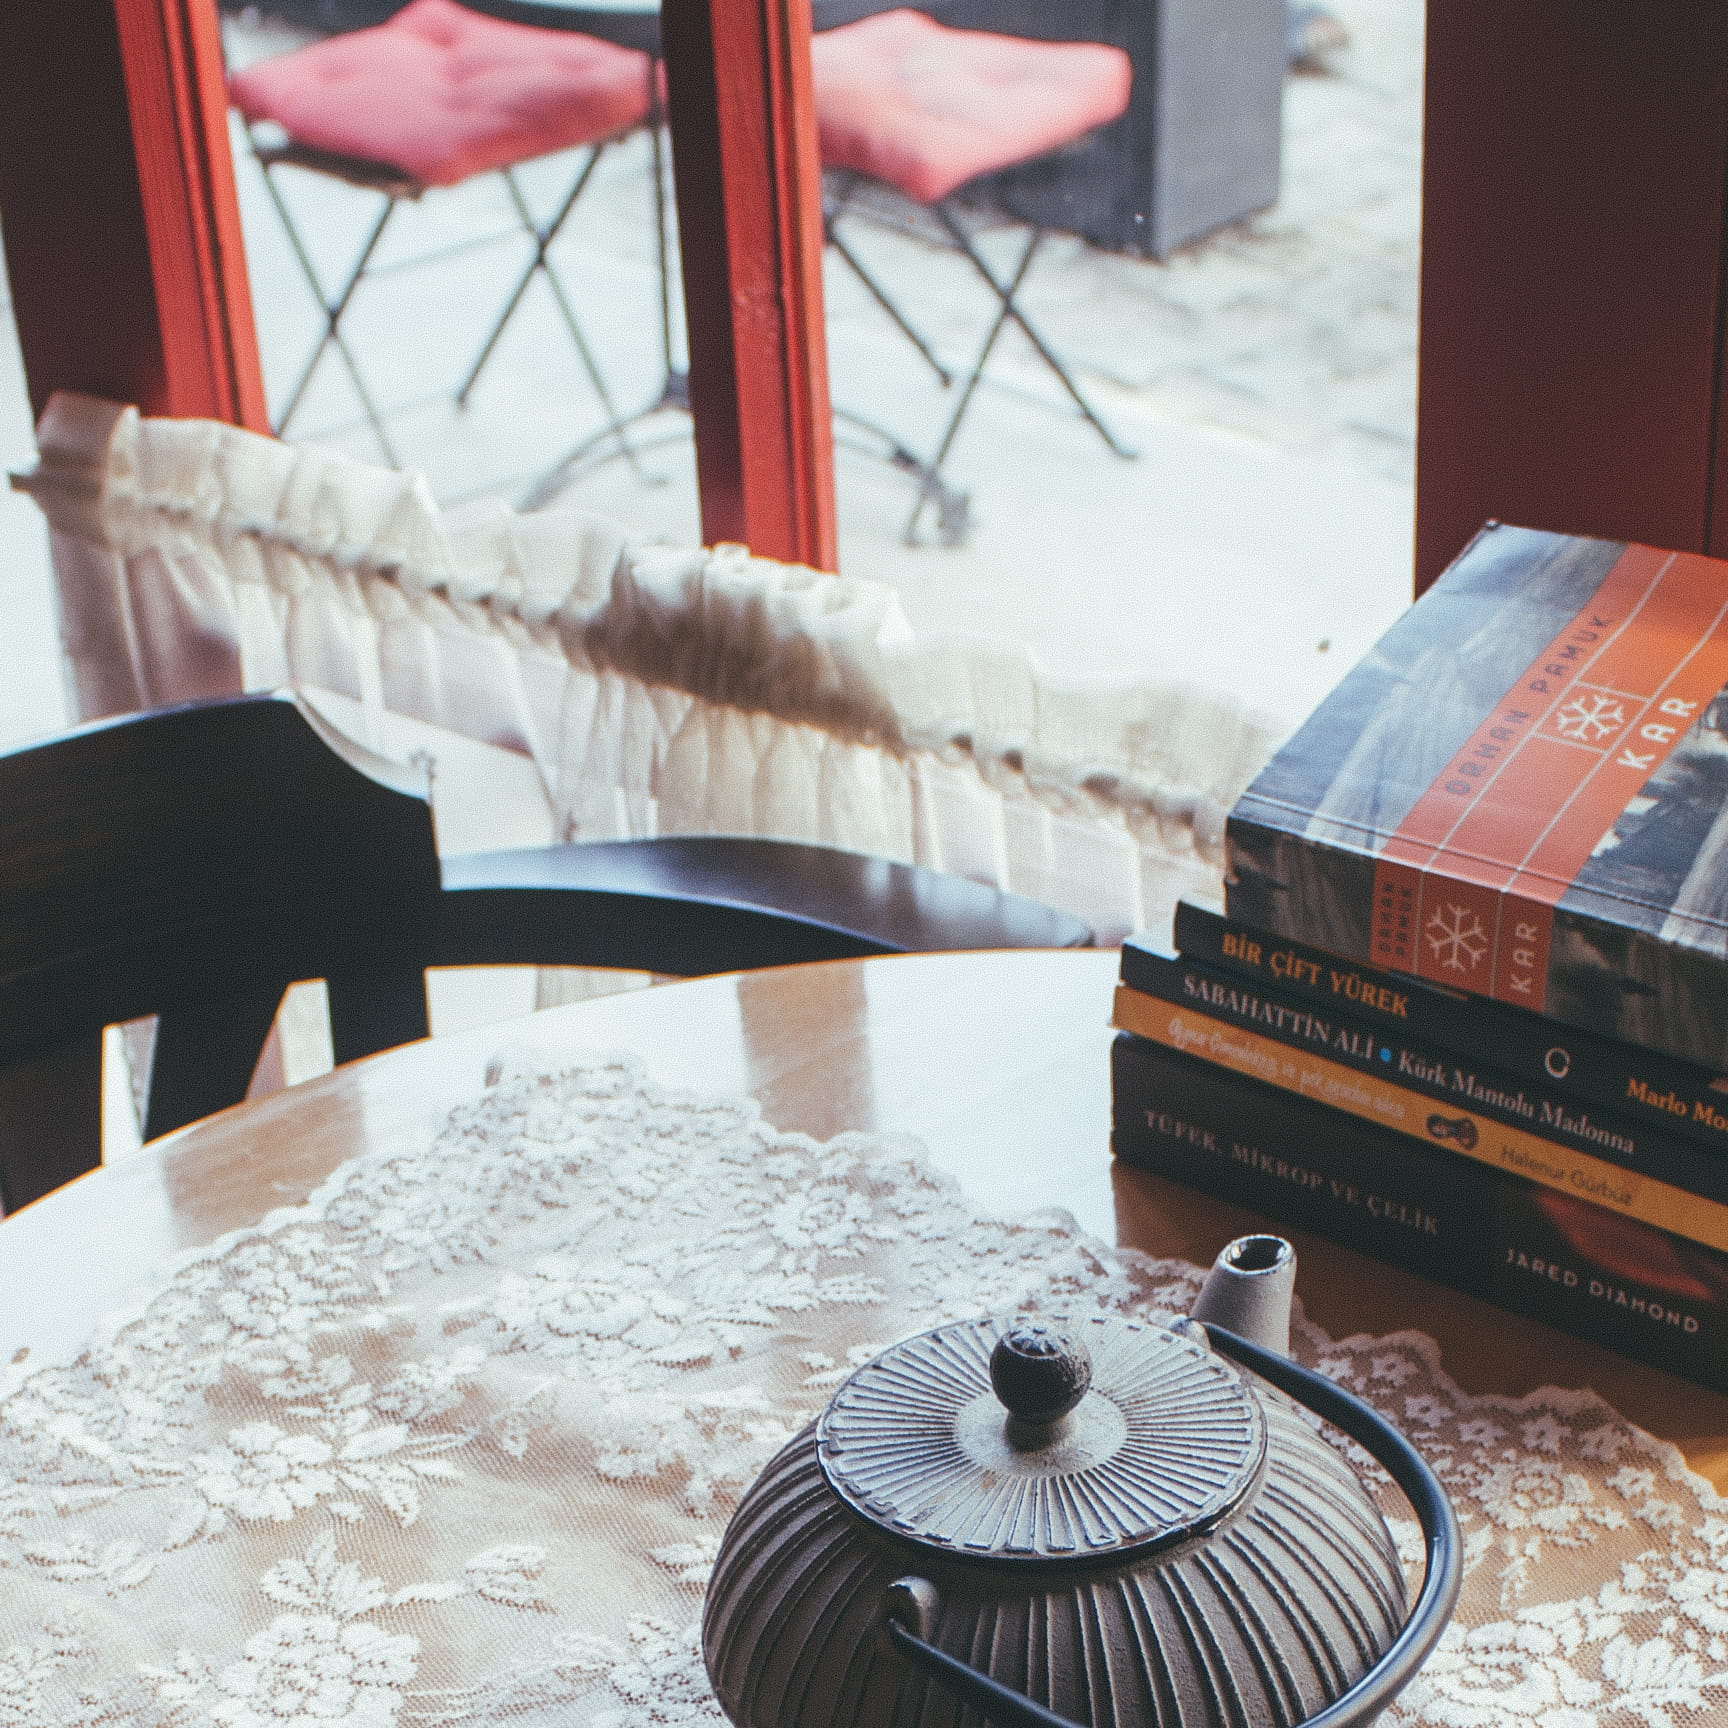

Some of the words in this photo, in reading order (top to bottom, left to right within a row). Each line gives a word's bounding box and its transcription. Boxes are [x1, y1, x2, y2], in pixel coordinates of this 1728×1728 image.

[1444, 708, 1530, 796] ORHAN
[1528, 615, 1614, 694] PAMUK
[1616, 697, 1698, 770] KAR
[1223, 931, 1263, 966] BİR
[1269, 950, 1322, 986] ÇİFT
[1329, 970, 1409, 1018] YÜREK
[1510, 921, 1539, 994] KAR
[1183, 974, 1331, 1043] SABAHATTİN
[1333, 1028, 1375, 1061] ALİ
[1399, 1049, 1448, 1088] Kürk
[1451, 1068, 1535, 1119] Mantolu
[1538, 1100, 1635, 1154] Madonna
[1626, 1076, 1688, 1117] Marlo
[1231, 1142, 1324, 1191] MİKROP
[1329, 1179, 1362, 1205] VE
[1366, 1194, 1440, 1236] ÇELİK
[1506, 1247, 1579, 1288] JARED
[1588, 1279, 1700, 1334] DIAMOND
